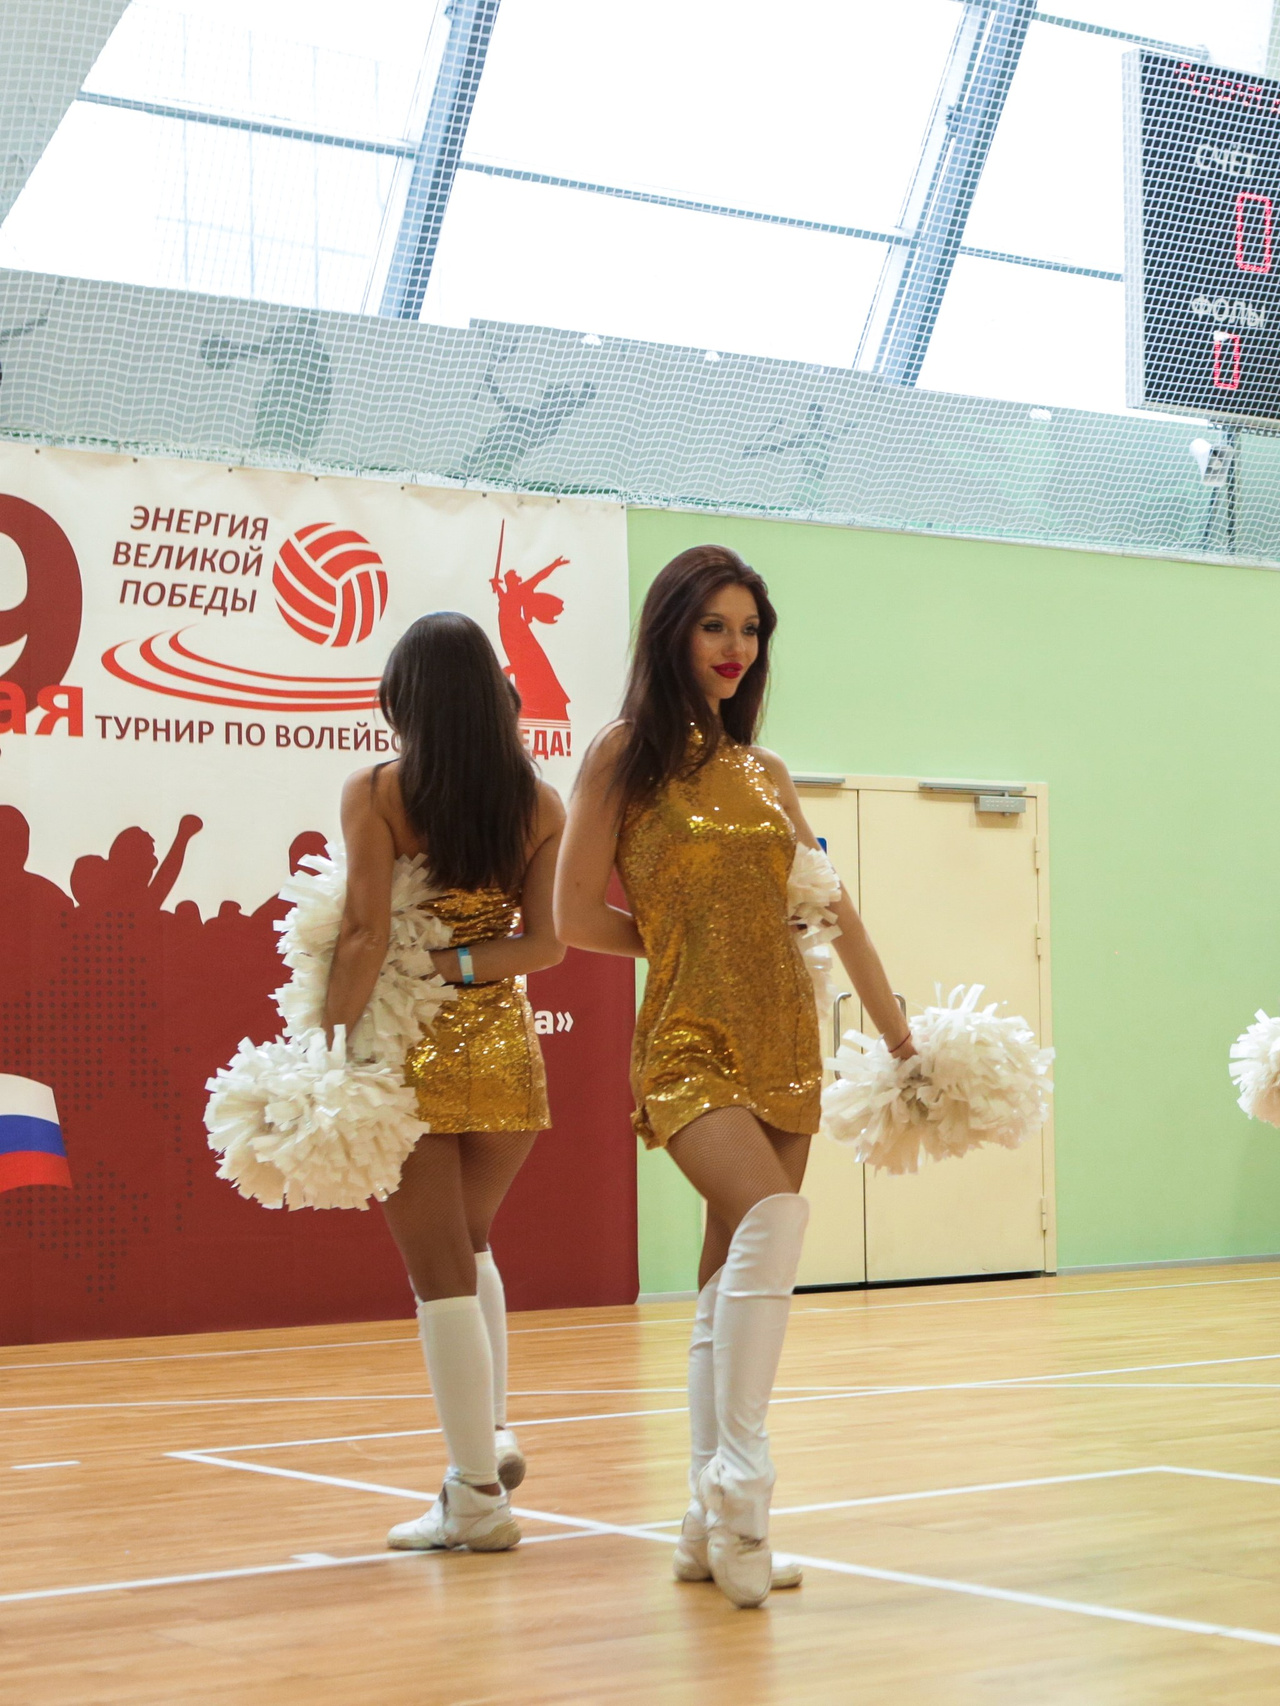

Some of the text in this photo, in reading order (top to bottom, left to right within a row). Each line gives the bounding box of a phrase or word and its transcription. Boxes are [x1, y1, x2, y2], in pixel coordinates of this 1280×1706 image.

[1236, 191, 1273, 274] 0
[1190, 293, 1267, 329] ФОЛЫ
[1213, 330, 1241, 390] 0
[130, 504, 270, 542] ЭНЕРГИЯ
[111, 540, 264, 578] ВЕЛИКОЙ
[118, 579, 258, 618] ПОБЕДЫ
[0, 680, 84, 738] ая
[94, 714, 215, 745] ТУРНИР
[224, 721, 267, 748] ПО
